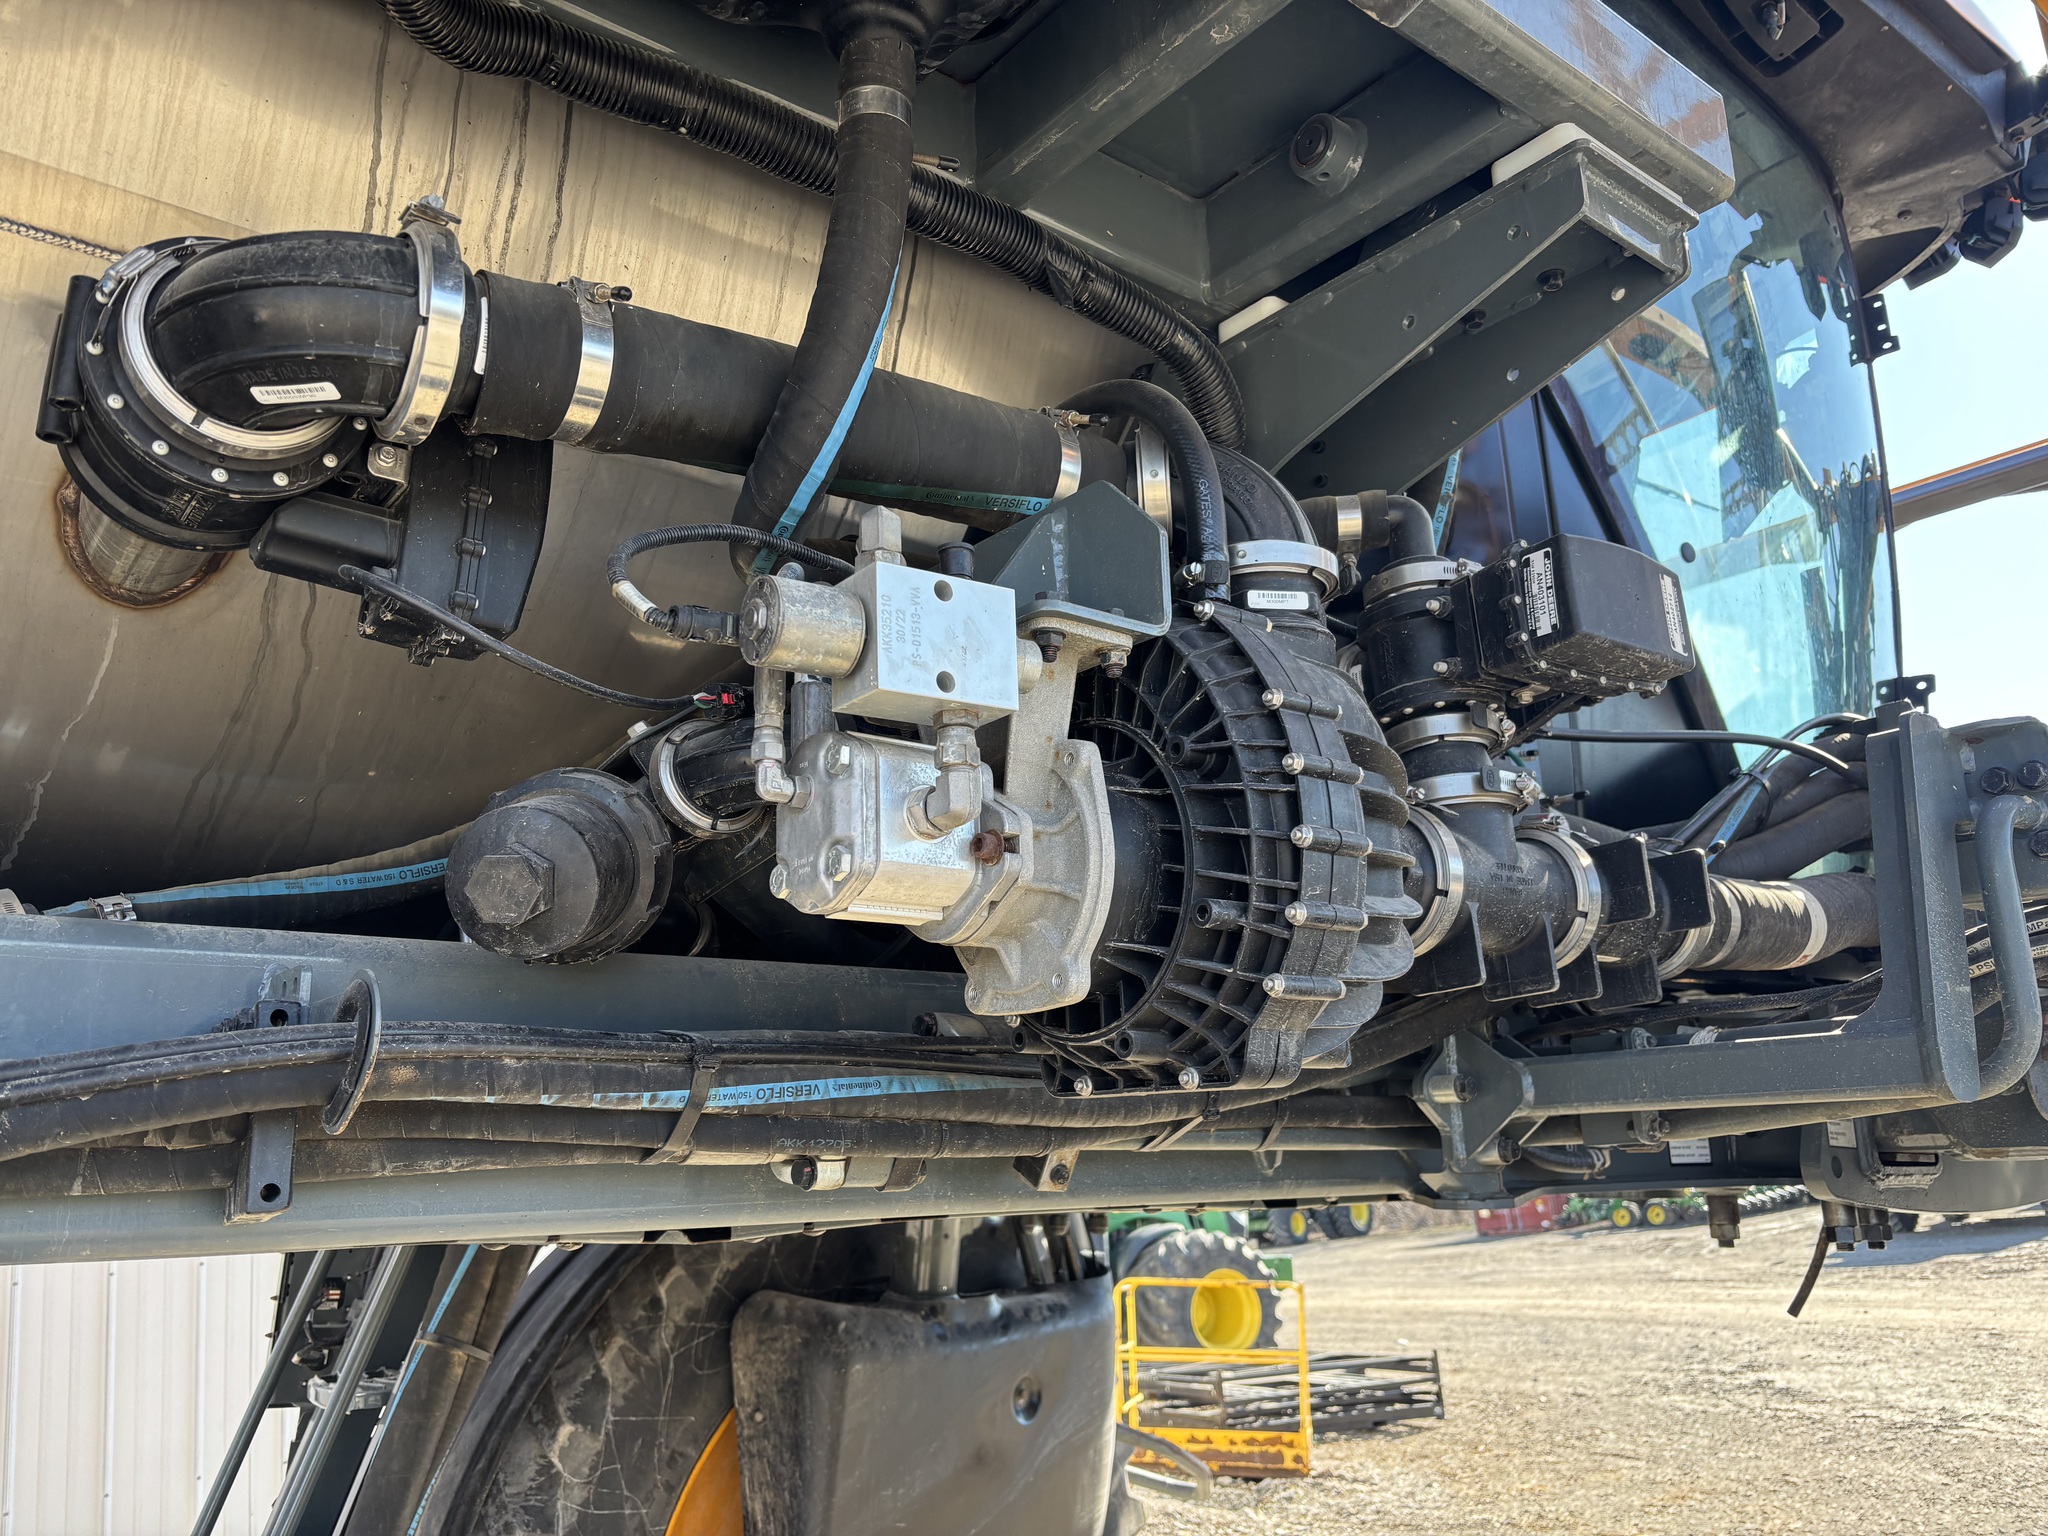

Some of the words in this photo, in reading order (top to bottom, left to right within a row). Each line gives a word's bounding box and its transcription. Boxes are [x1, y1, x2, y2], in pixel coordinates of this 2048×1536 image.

[239, 368, 278, 386] MADE
[278, 366, 293, 380] IN
[296, 366, 339, 379] U.S.A.
[985, 496, 1043, 512] VERSIFLO
[1544, 558, 1553, 587] JOHN
[1536, 572, 1547, 616] AN403101
[1547, 588, 1557, 625] DEERE
[880, 594, 893, 654] AKK35210
[895, 607, 906, 644] 30/22
[910, 586, 922, 667] PS-01513-VVA
[357, 873, 384, 885] WATER
[384, 872, 396, 882] 150
[399, 861, 446, 880] ERSIFLO
[336, 878, 343, 887] D
[343, 877, 349, 886] &
[349, 877, 356, 885] S
[737, 1090, 752, 1100] 150
[756, 1083, 821, 1100] VERSIFLO
